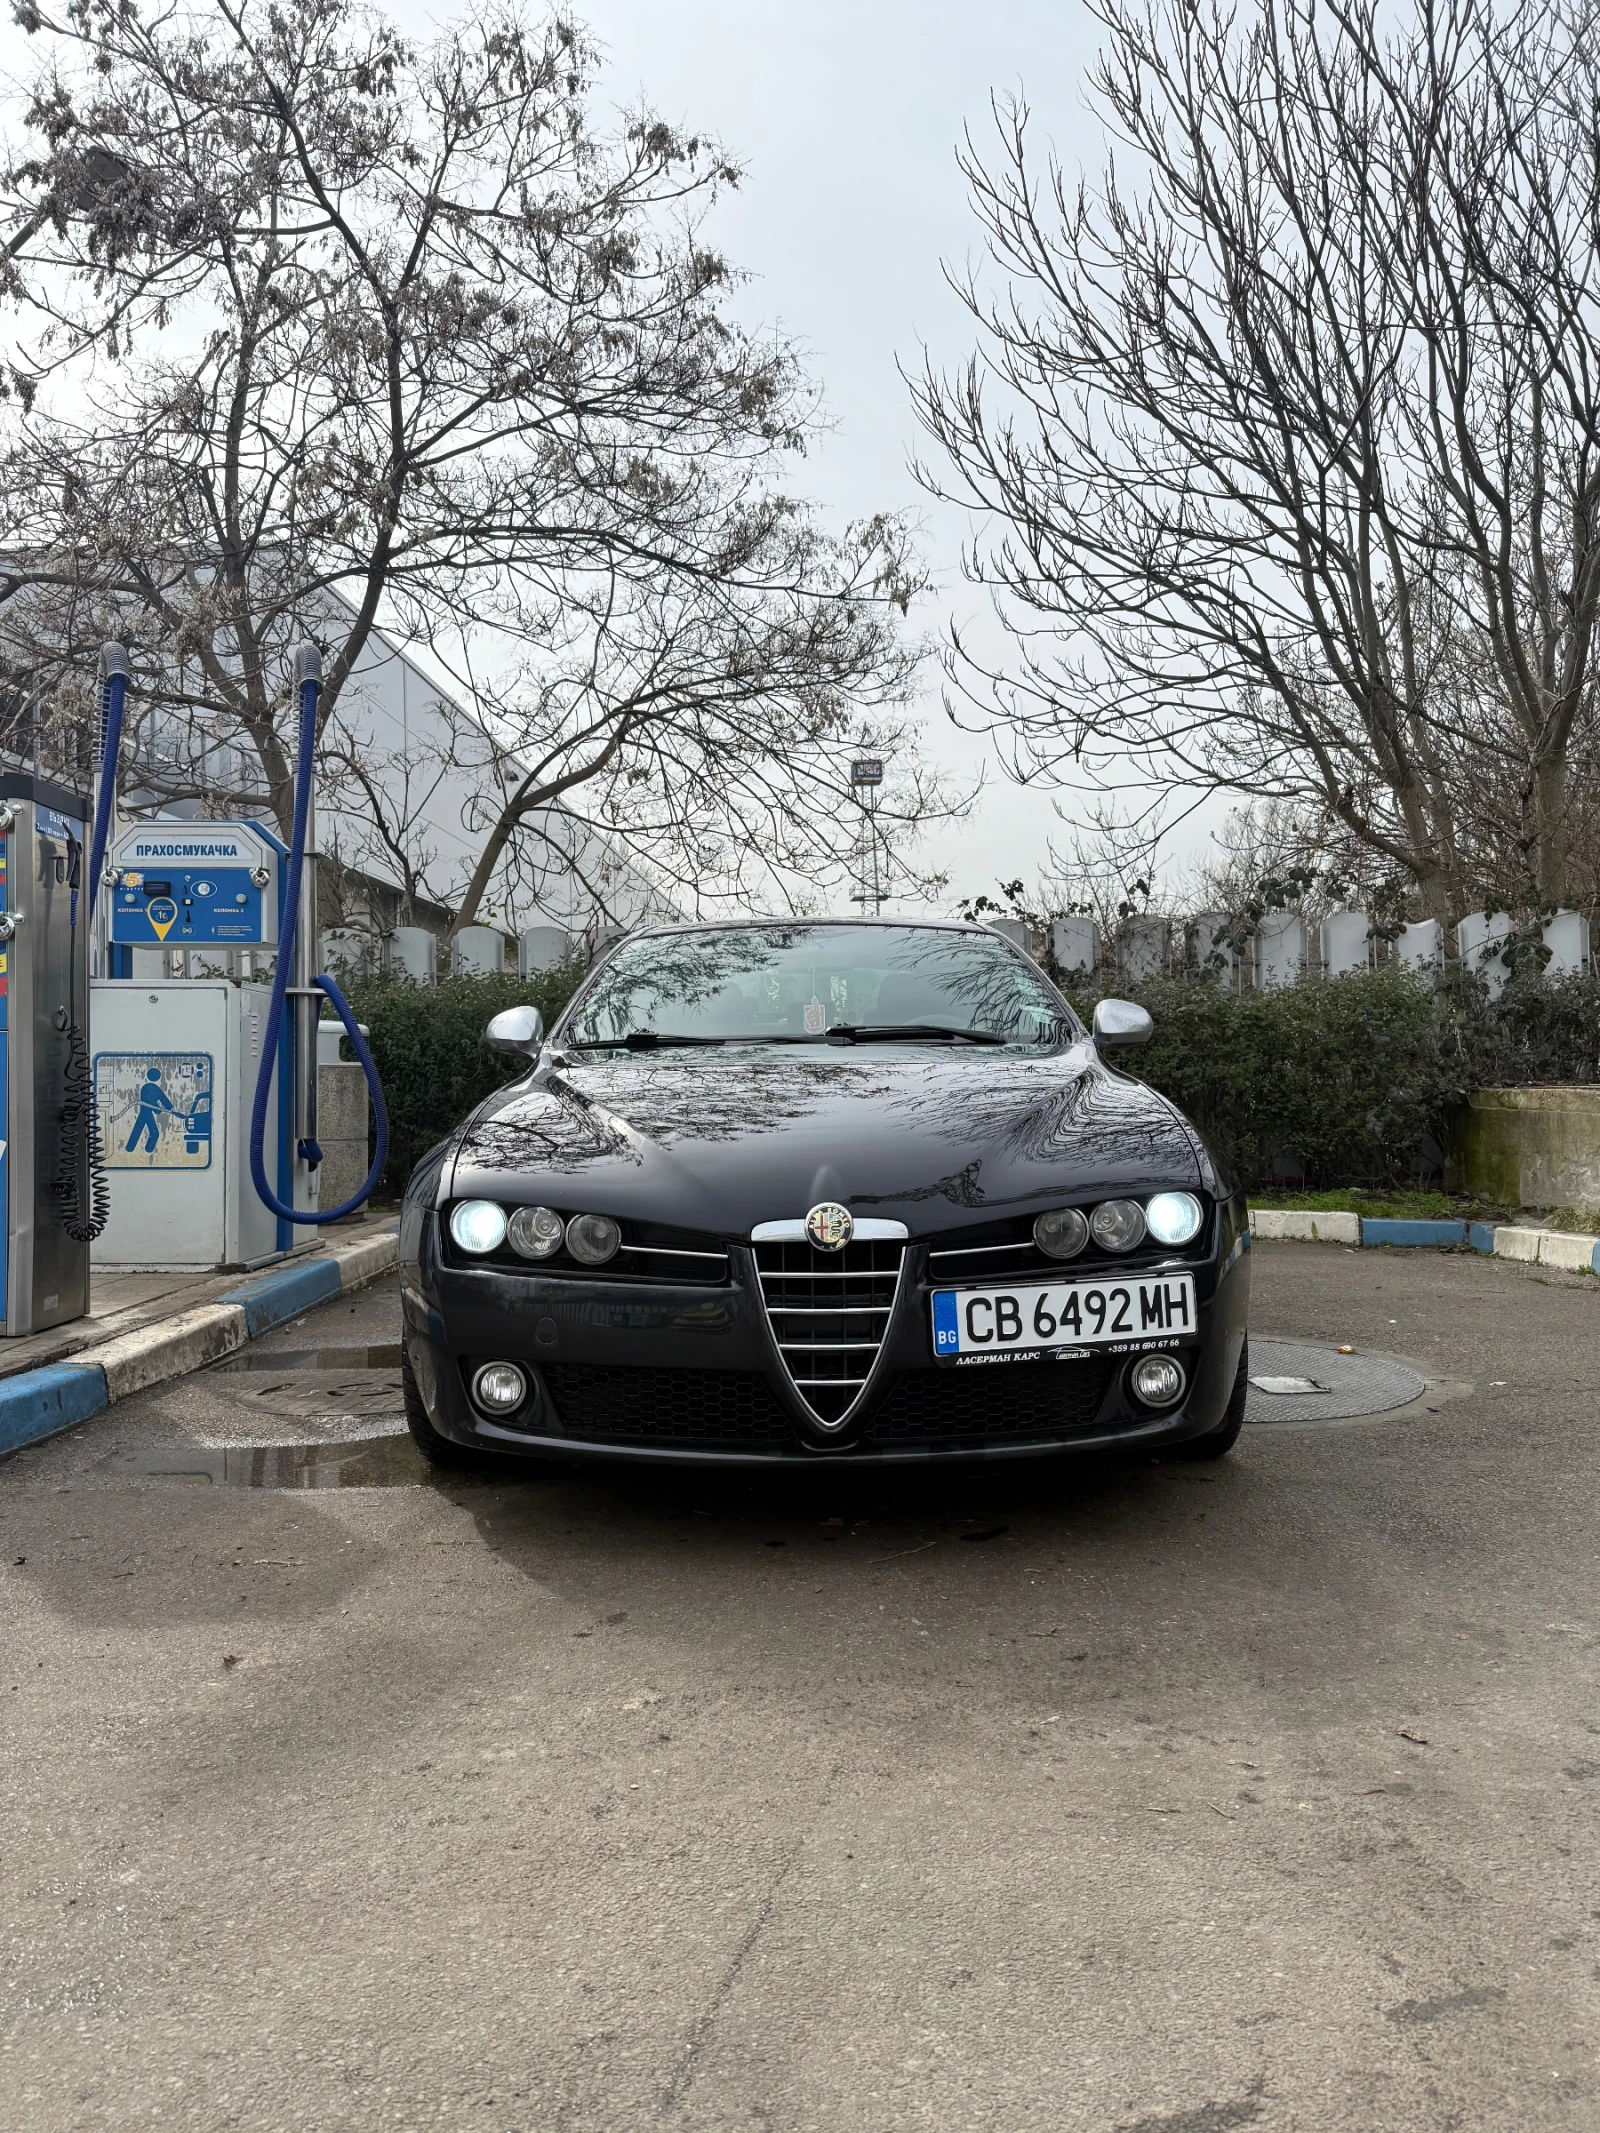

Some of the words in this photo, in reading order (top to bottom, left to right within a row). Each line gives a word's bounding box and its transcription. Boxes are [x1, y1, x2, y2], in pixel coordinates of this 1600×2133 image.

[136, 844, 238, 857] ПРАХОСМУКАЧКА
[125, 872, 140, 888] 5
[966, 1294, 1023, 1343] CB
[1033, 1288, 1133, 1338] 6492
[1139, 1282, 1189, 1331] MH
[938, 1330, 957, 1345] BG
[1108, 1344, 1128, 1354] +359
[1142, 1342, 1156, 1350] 690
[1158, 1340, 1168, 1348] 67
[1170, 1338, 1180, 1347] 66
[956, 1354, 1011, 1365] ЛАСЕРМАН
[1013, 1352, 1040, 1361] КАРС
